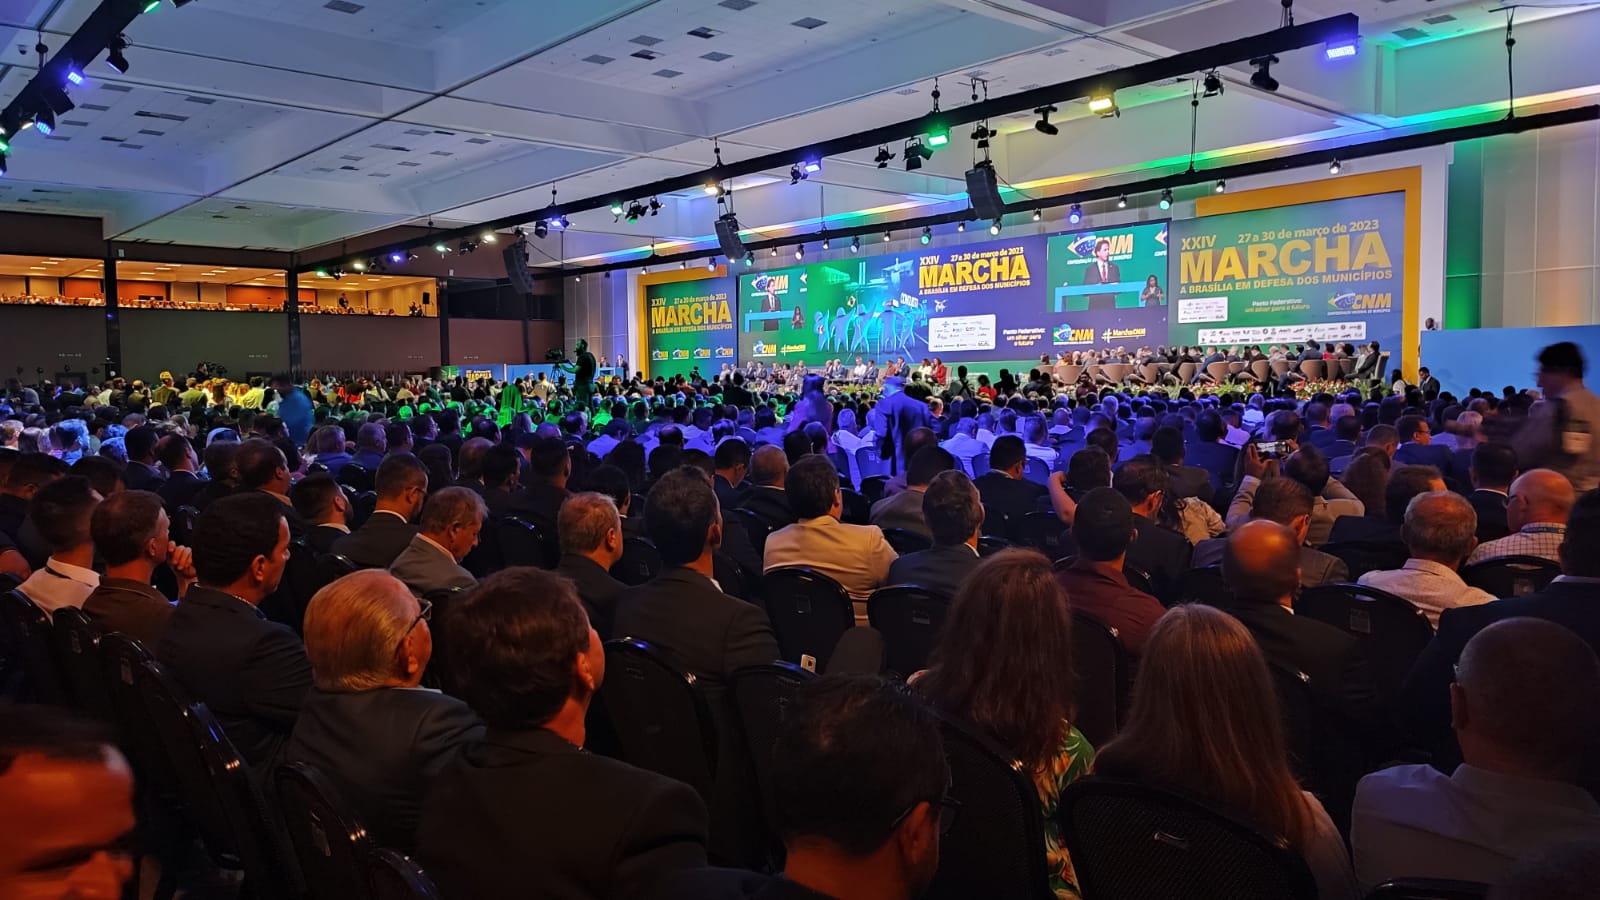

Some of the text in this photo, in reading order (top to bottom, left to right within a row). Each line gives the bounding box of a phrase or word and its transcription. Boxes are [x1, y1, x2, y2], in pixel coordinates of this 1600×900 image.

[1238, 219, 1379, 244] 27 a 30 de março de 2023
[1092, 233, 1133, 257] NM
[1181, 235, 1216, 250] XXIV
[972, 251, 979, 259] de
[1000, 248, 1007, 256] de
[1008, 246, 1024, 255] 2023
[1180, 231, 1392, 284] MARCHA
[919, 255, 940, 266] XXIV
[919, 255, 1030, 289] MARCHA
[981, 282, 993, 290] DOS
[1180, 270, 1393, 294] A BRASÍLIA EM DEFESA DOS MUNICÍPIOS
[651, 297, 667, 306] XXIV
[1352, 293, 1391, 309] CNM
[652, 300, 732, 328] MARCHA
[1070, 328, 1094, 342] CNM
[762, 344, 776, 354] CNM
